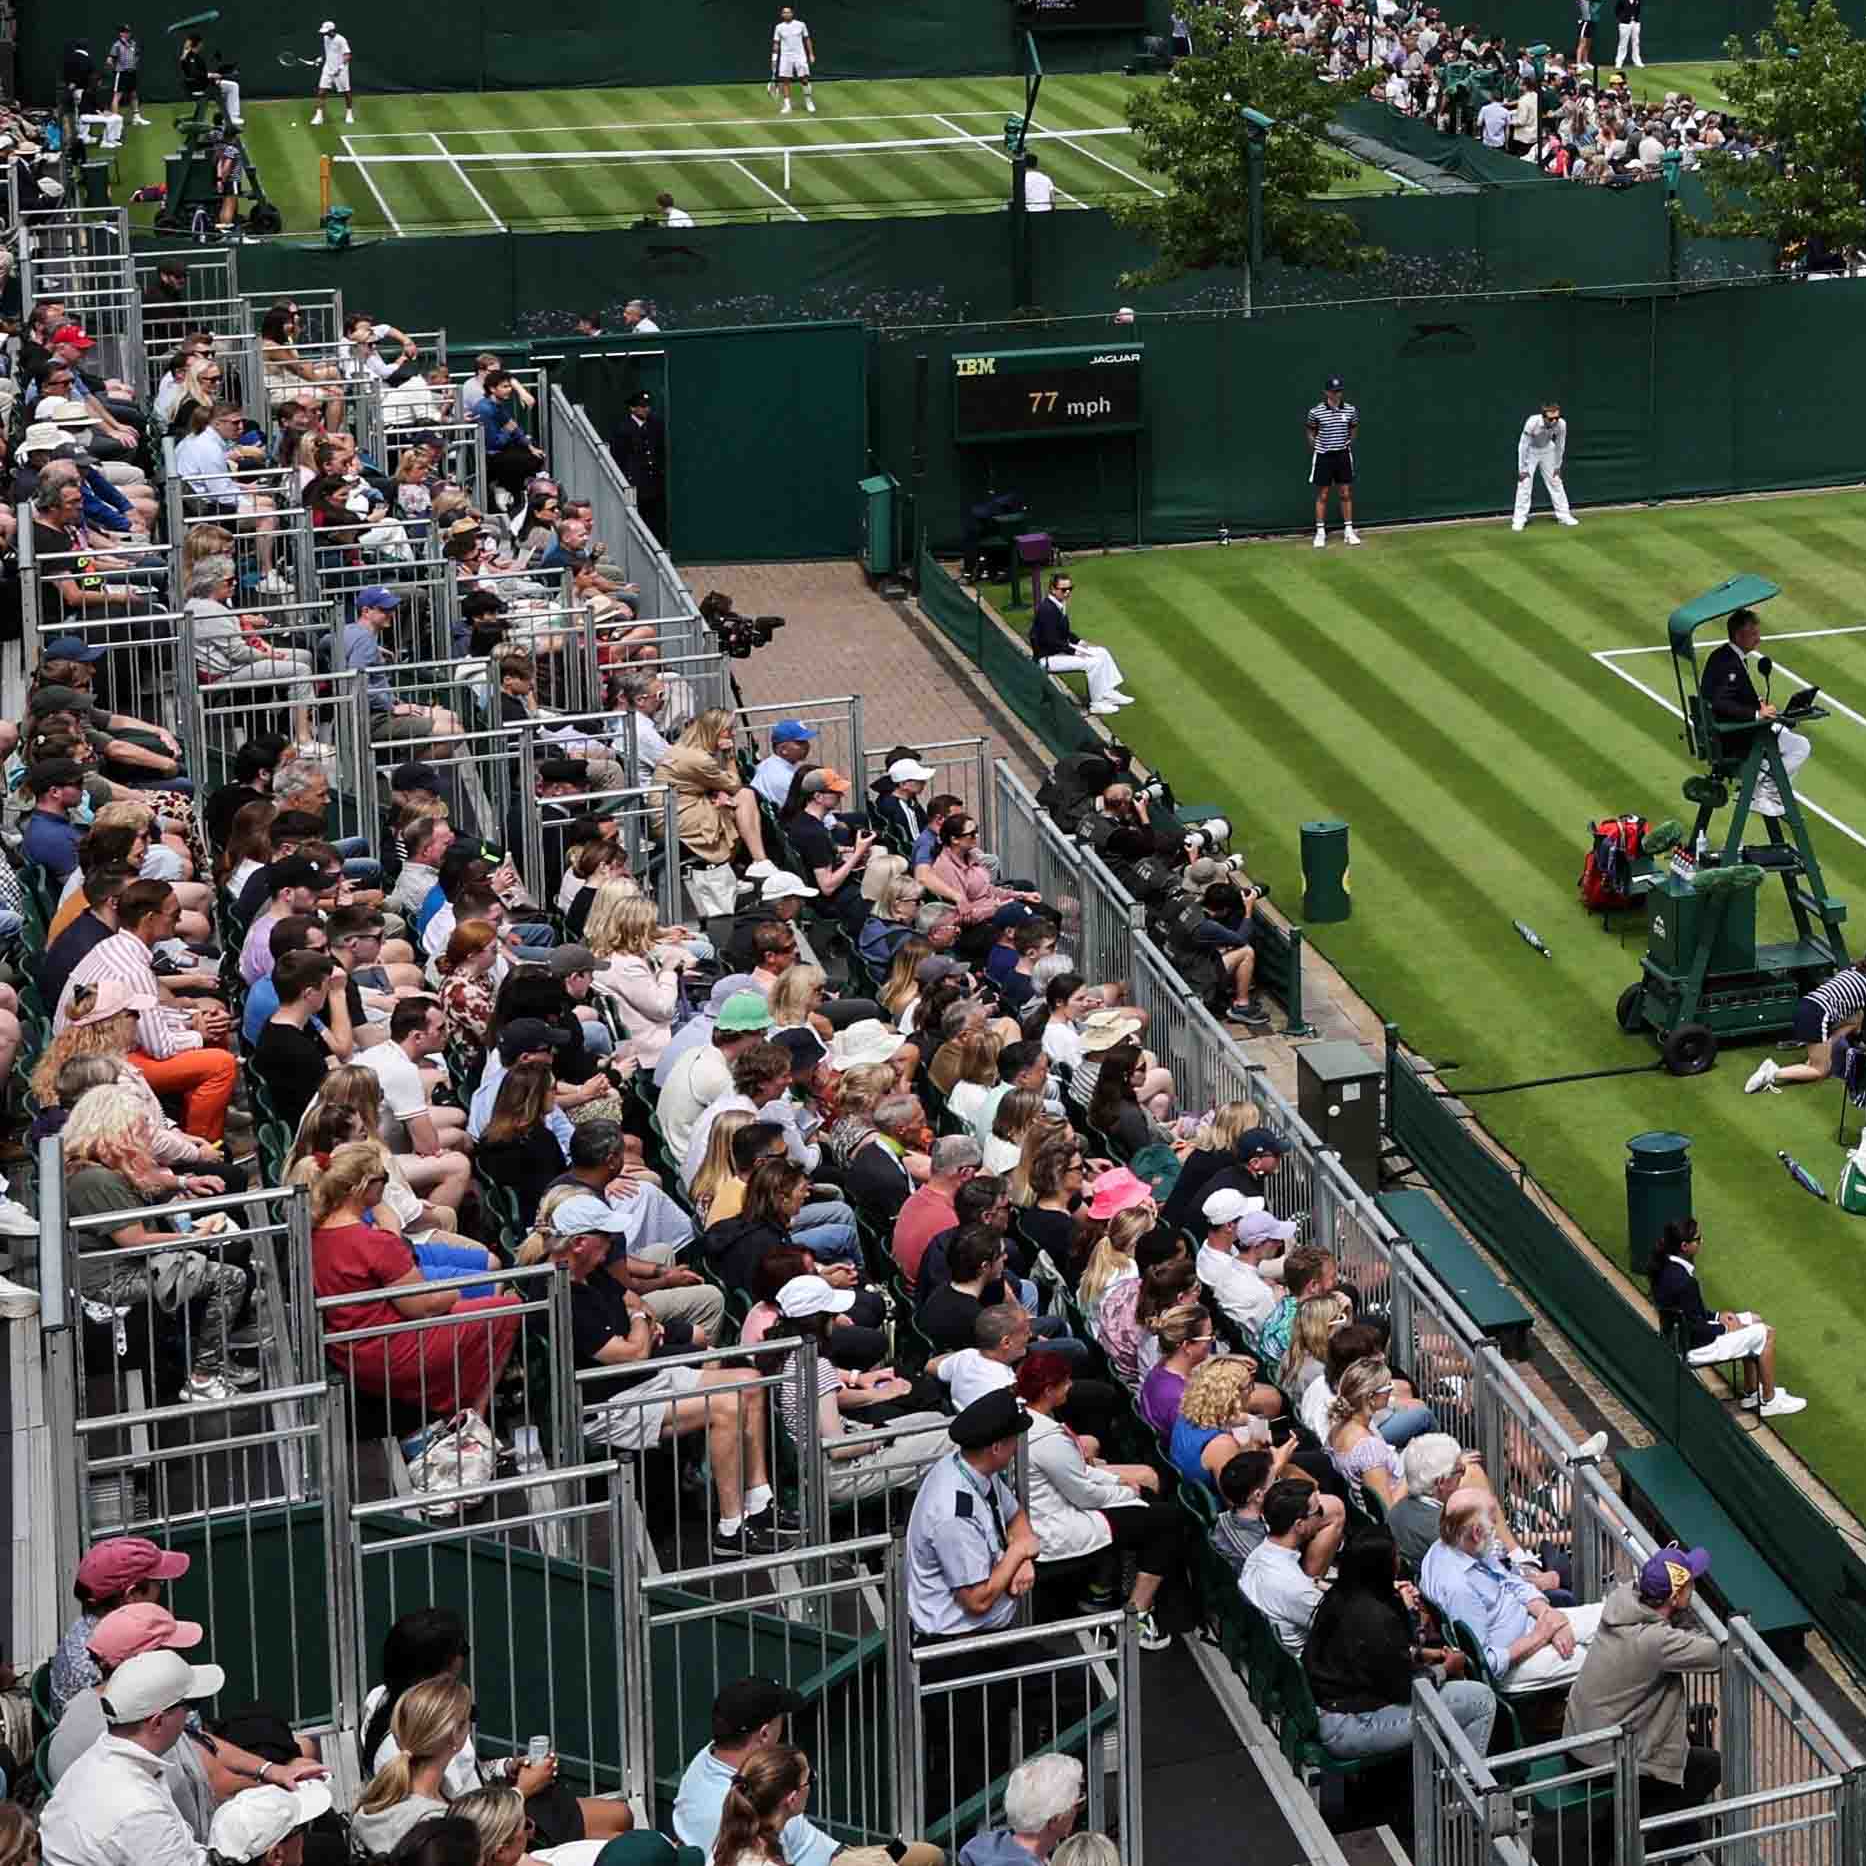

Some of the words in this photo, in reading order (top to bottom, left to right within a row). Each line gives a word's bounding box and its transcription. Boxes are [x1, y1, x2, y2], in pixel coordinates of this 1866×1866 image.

[956, 357, 996, 376] IBM
[1089, 353, 1141, 365] JAGUAR
[1028, 391, 1059, 413] 77
[1066, 396, 1112, 417] mph
